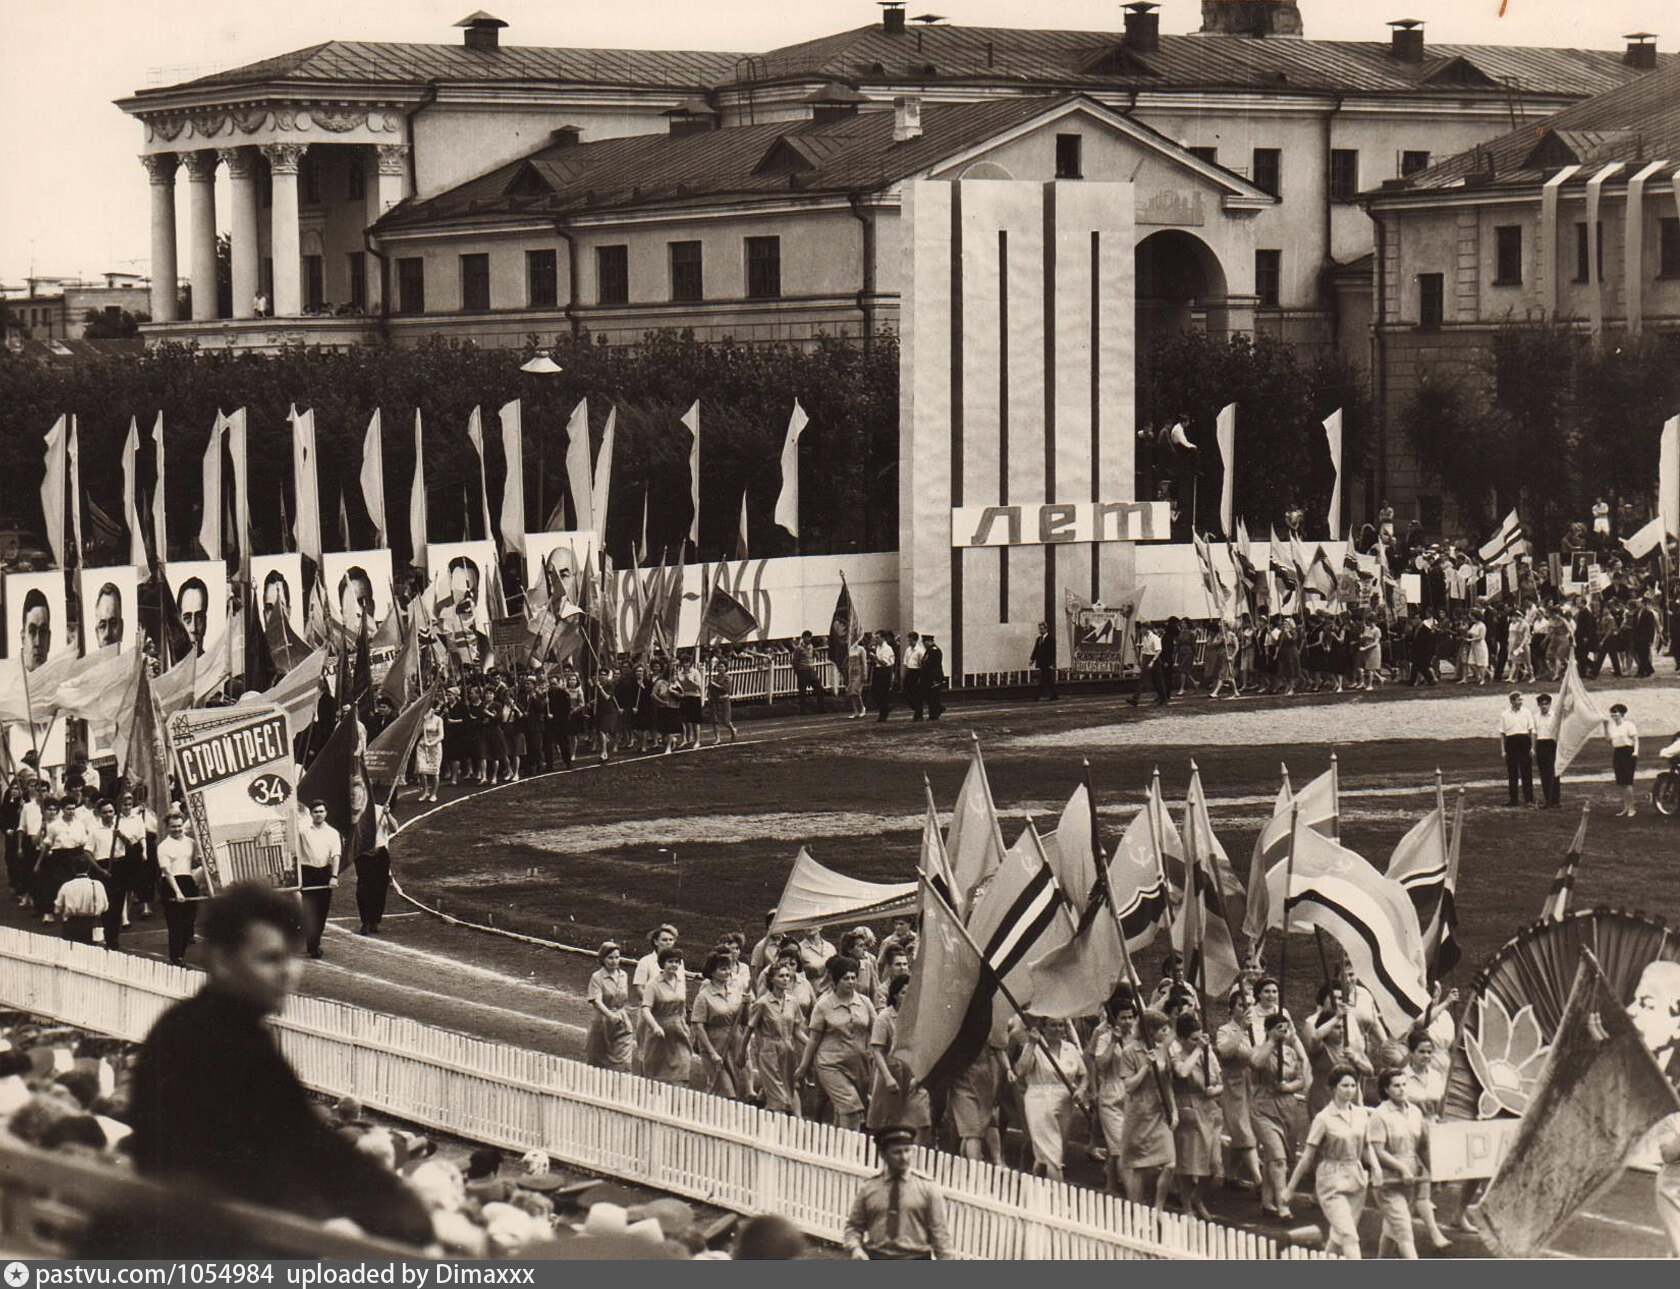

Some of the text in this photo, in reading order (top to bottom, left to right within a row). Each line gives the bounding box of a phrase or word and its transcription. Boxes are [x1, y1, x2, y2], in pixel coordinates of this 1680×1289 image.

[971, 502, 1155, 546] лет
[181, 720, 284, 786] СТРОЙТРЕСТ
[253, 776, 284, 805] 34
